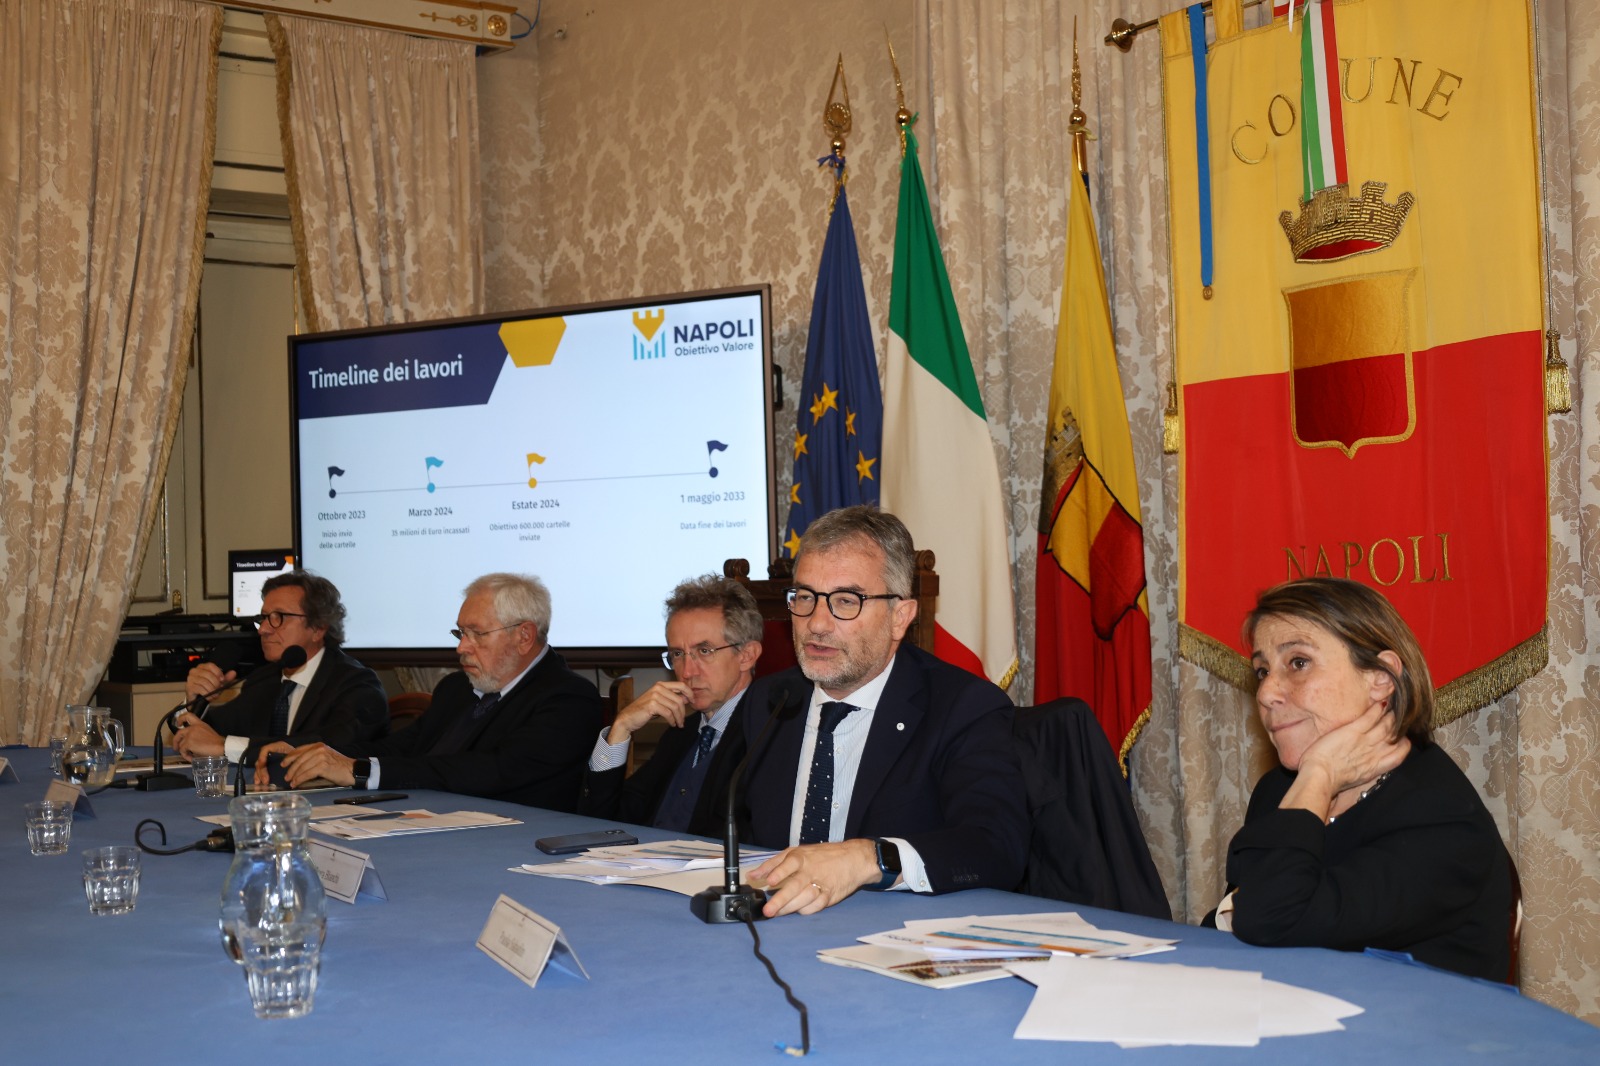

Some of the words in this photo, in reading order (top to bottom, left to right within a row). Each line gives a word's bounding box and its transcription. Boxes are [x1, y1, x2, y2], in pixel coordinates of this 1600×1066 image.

[1231, 57, 1463, 165] COUNE
[674, 318, 754, 344] NAPOLI
[674, 344, 720, 357] Obiettivo
[721, 342, 754, 352] Valore
[308, 364, 379, 389] Timeline
[383, 359, 409, 382] dei
[414, 353, 463, 379] lavori
[680, 494, 685, 503] 1
[687, 491, 721, 505] maggio
[723, 491, 746, 501] 2033
[511, 500, 538, 510] Estate
[540, 499, 560, 509] 2024
[317, 511, 347, 521] Ottobre
[348, 510, 366, 519] 2023
[408, 508, 432, 517] Marzo
[434, 507, 453, 516] 2024
[489, 522, 518, 531] Obiettivo
[519, 521, 545, 530] 600.000
[546, 520, 571, 528] cartelle
[680, 522, 696, 530] Data
[698, 520, 711, 529] fine
[713, 520, 725, 529] dei
[726, 519, 746, 528] lavori
[322, 530, 338, 538] Inizio
[338, 529, 353, 537] invio
[391, 529, 399, 537] 35
[400, 528, 420, 536] milioni
[421, 527, 427, 535] di
[428, 527, 442, 535] Euro
[443, 525, 470, 535] incassati
[519, 532, 541, 541] inviate
[319, 541, 333, 549] delle
[334, 541, 356, 549] cartelle
[1281, 532, 1454, 586] NAPOLI
